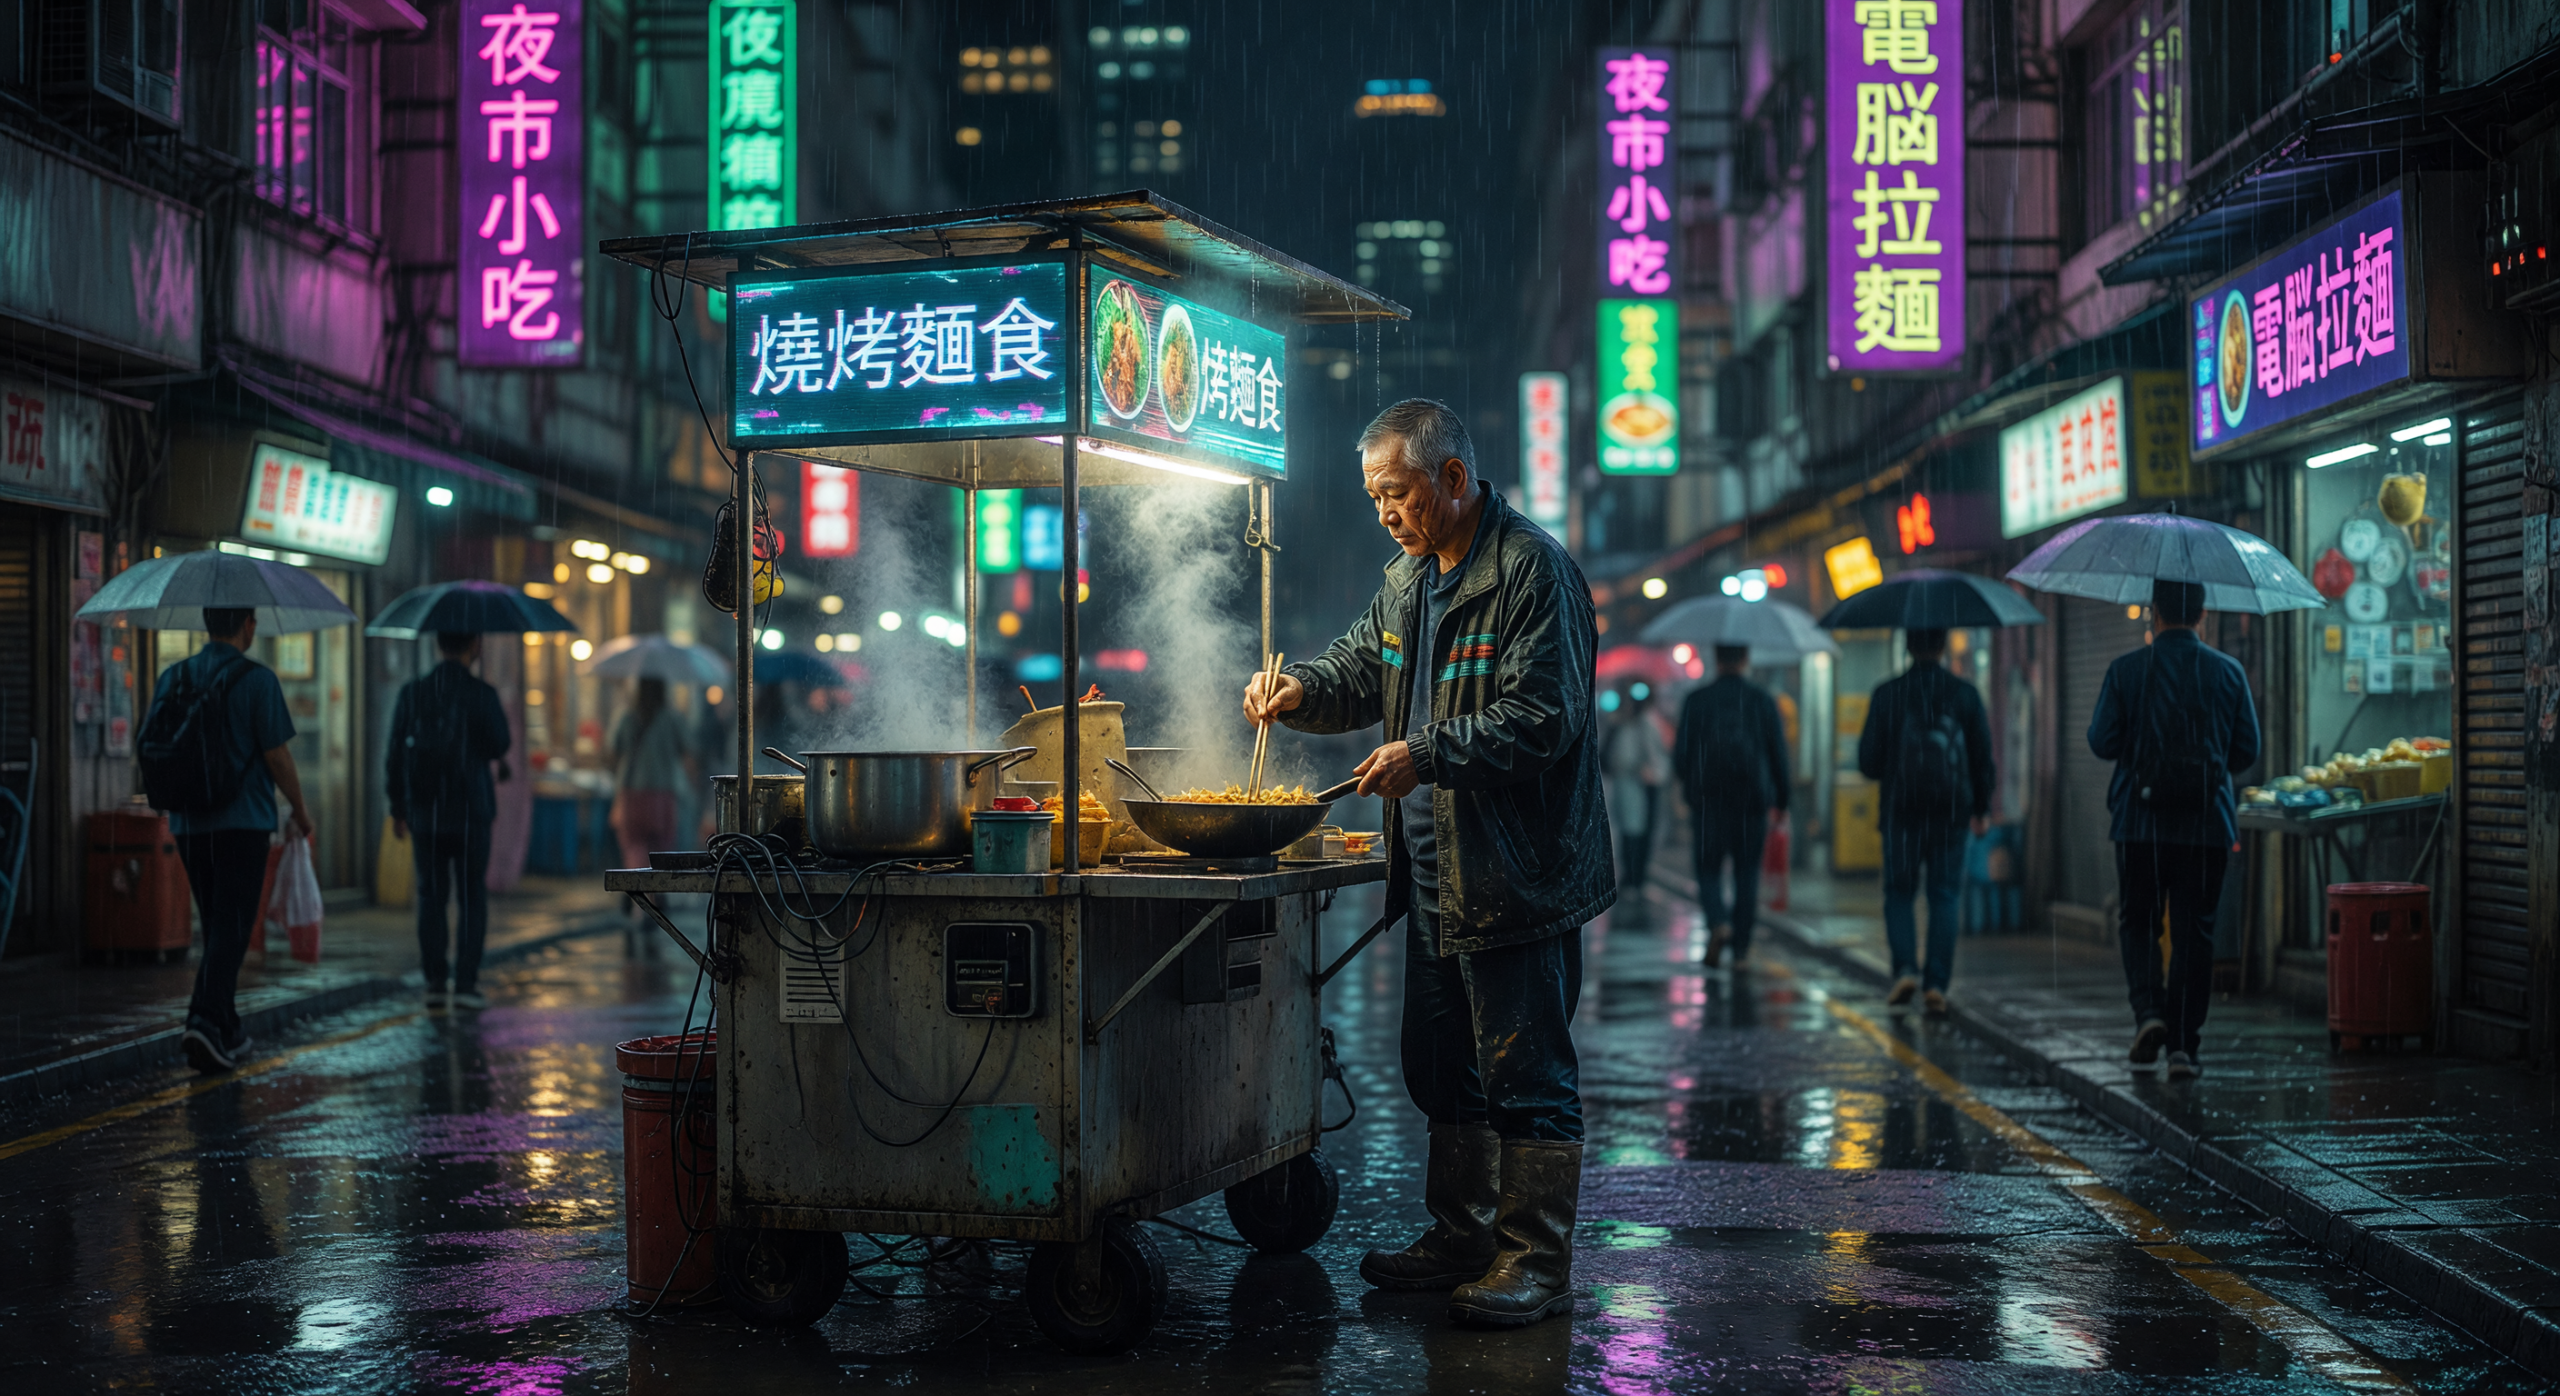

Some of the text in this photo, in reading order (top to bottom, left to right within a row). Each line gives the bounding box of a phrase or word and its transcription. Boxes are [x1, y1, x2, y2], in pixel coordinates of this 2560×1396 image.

[478, 3, 561, 341] 夜市小吃
[1605, 53, 1671, 294] 夜市小吃
[749, 297, 1056, 396] 燒烤麵食
